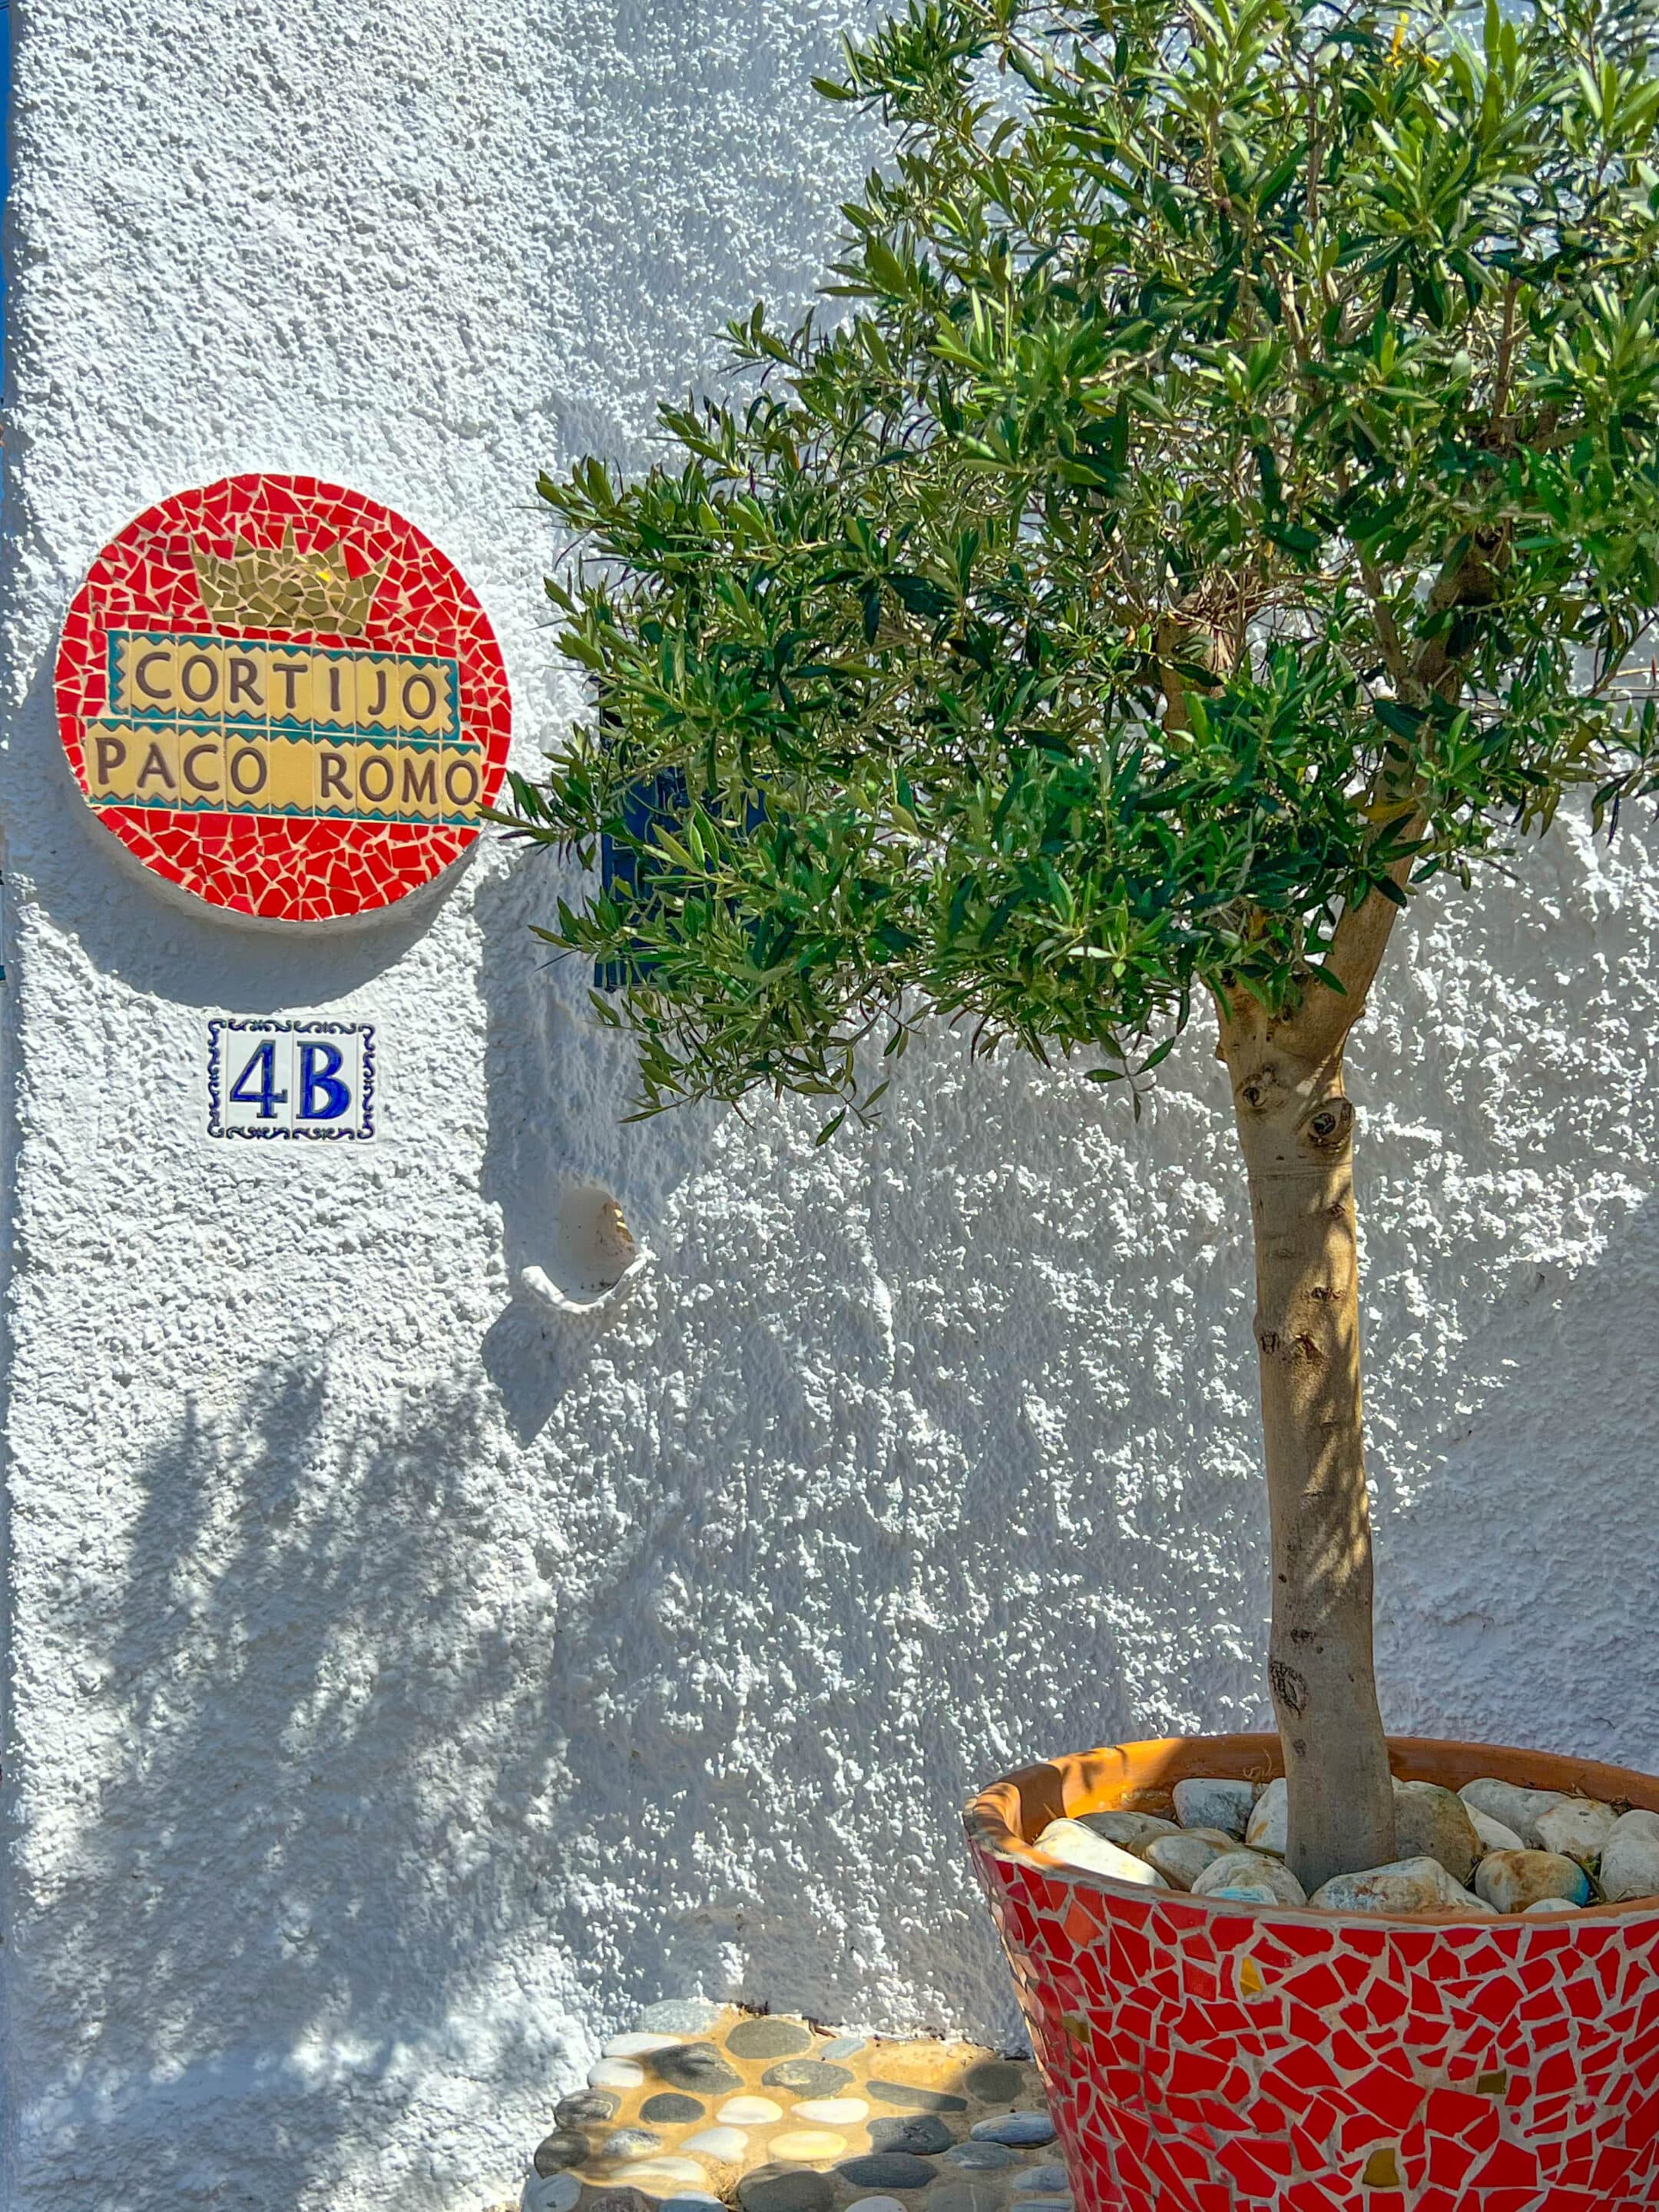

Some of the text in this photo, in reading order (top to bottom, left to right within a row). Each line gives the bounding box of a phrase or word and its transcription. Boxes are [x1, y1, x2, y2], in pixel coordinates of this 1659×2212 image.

[135, 652, 437, 720] CORTIJO
[95, 737, 479, 806] PACO ROMO
[229, 1039, 352, 1119] 4B
